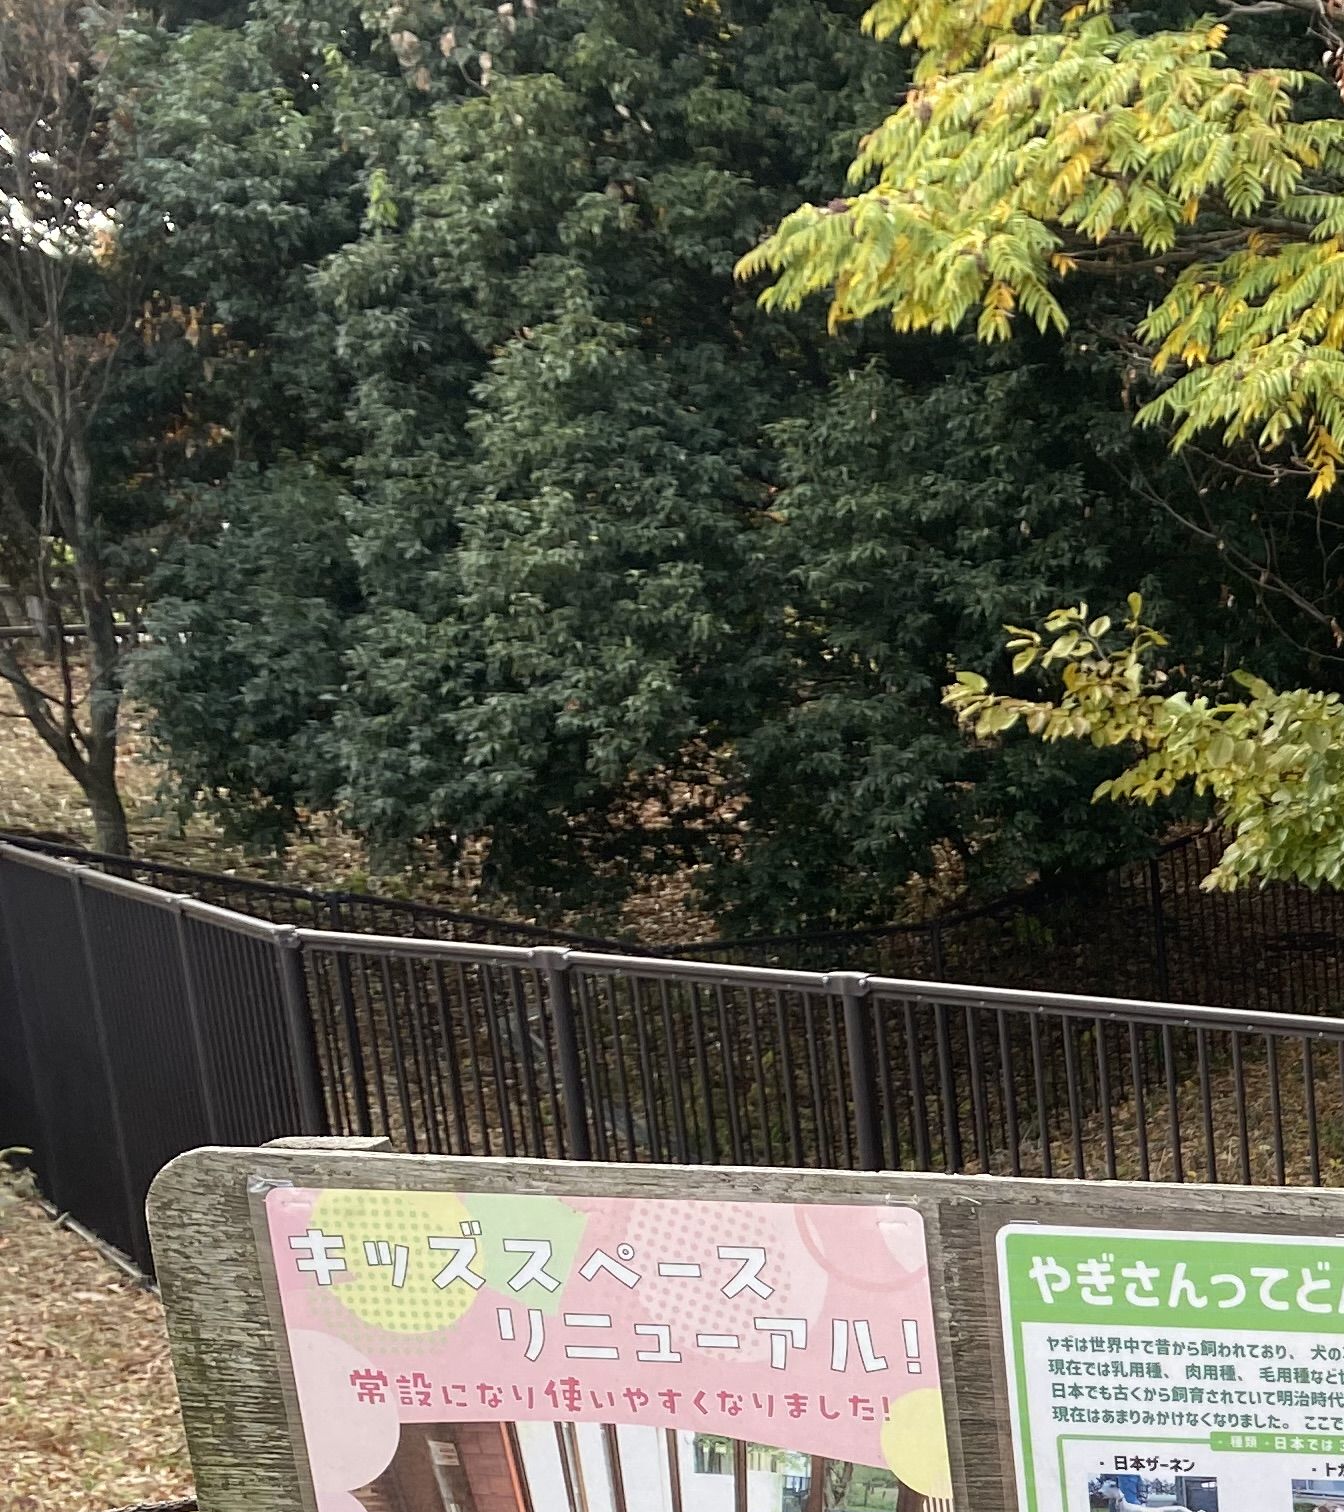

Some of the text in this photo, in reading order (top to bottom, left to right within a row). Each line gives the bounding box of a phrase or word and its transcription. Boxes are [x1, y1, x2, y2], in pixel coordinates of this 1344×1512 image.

[288, 1220, 775, 1300] キッズスペース
[496, 1307, 923, 1375] リニューアル！
[349, 1368, 892, 1421] 常設になり使いやすくなりました！
